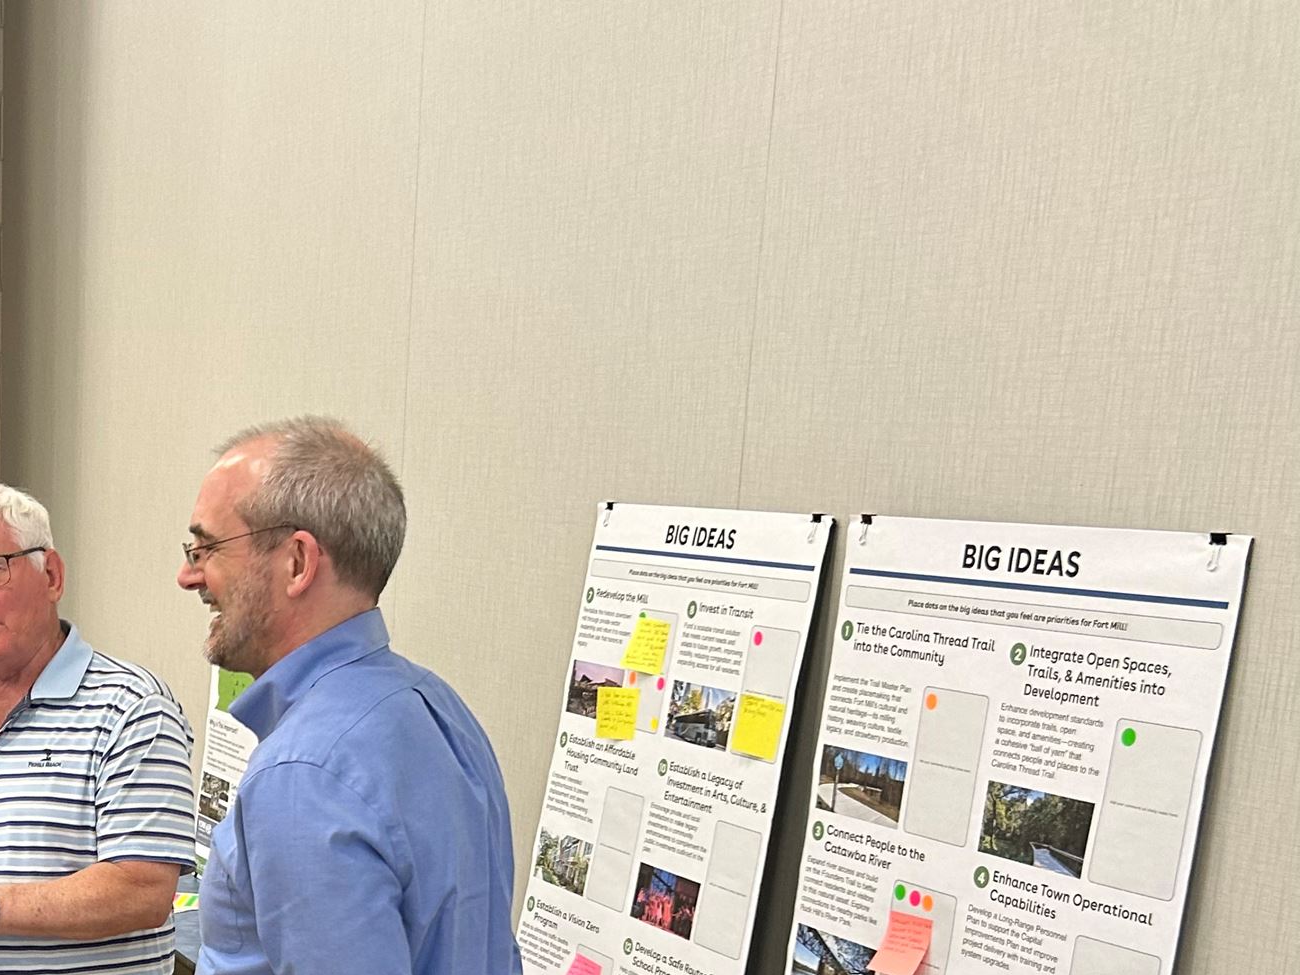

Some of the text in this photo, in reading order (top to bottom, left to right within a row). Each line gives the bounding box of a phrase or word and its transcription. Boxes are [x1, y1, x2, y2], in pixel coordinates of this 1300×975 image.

[665, 525, 737, 550] BIG IDEAS
[962, 544, 1081, 578] BIG IDEAS
[596, 588, 625, 603] Redevelop
[626, 593, 635, 602] the
[636, 594, 649, 604] Mill
[699, 602, 754, 619] Invest in Transit
[908, 599, 924, 608] Place
[960, 606, 970, 615] big
[971, 606, 988, 616] ideas
[990, 609, 1005, 618] that
[1006, 612, 1019, 620] you
[1020, 612, 1032, 620] feel
[1047, 615, 1079, 626] priorities
[1081, 618, 1092, 627] for
[1093, 620, 1109, 629] Fort
[1110, 622, 1128, 631] Mill!
[857, 622, 870, 634] Tie
[872, 625, 886, 637] the
[888, 627, 930, 642] Carolina
[933, 632, 970, 648] Thread
[972, 637, 995, 652] Trail
[853, 639, 945, 667] into the Community
[1029, 645, 1084, 664] Integrate
[1086, 652, 1120, 669] Open
[1122, 657, 1172, 677] Spaces,
[1027, 664, 1166, 696] Trails, & Amenities into
[1024, 684, 1100, 707] Development
[1001, 703, 1104, 728] Enhance development standards
[1007, 717, 1040, 729] incorporate
[1060, 726, 1077, 735] open
[997, 726, 1016, 736] space,
[1018, 730, 1030, 738] and
[569, 734, 595, 749] Establish
[604, 744, 636, 760] Affordable
[1001, 739, 1028, 750] cohesive
[1069, 752, 1082, 760] that
[565, 760, 579, 772] Trust
[566, 747, 639, 776] Housing Community Land
[991, 759, 1017, 771] Carolina
[1019, 765, 1040, 776] Thread
[993, 749, 1020, 760] connects
[1022, 755, 1042, 764] people
[1044, 759, 1056, 767] and
[1057, 761, 1078, 772] places
[1088, 767, 1100, 776] the
[670, 761, 700, 780] Establish
[708, 772, 733, 790] Legacy
[734, 780, 744, 790] of
[664, 791, 712, 814] Entertainment
[667, 776, 766, 814] Investment in Arts, Culture, &
[824, 841, 892, 869] Catawba River
[827, 825, 864, 844] Connect
[865, 835, 896, 853] People
[898, 846, 908, 856] to
[910, 848, 926, 861] the
[990, 889, 1057, 919] Capabilities
[993, 870, 1038, 894] Enhance
[1041, 884, 1070, 903] Town
[1073, 894, 1153, 926] Operational
[534, 912, 558, 930] Program
[536, 900, 562, 918] Establish
[568, 915, 585, 928] Vision
[586, 921, 600, 933] Zero
[966, 915, 980, 924] Plan
[988, 923, 1010, 934] support
[1010, 929, 1020, 938] the
[1021, 932, 1042, 945] Capital
[968, 904, 992, 918] Develop
[999, 914, 1034, 932] Long-Range
[1036, 925, 1067, 941] Personnel
[632, 957, 654, 974] School
[635, 942, 661, 964] Develop
[668, 956, 684, 969] Safe
